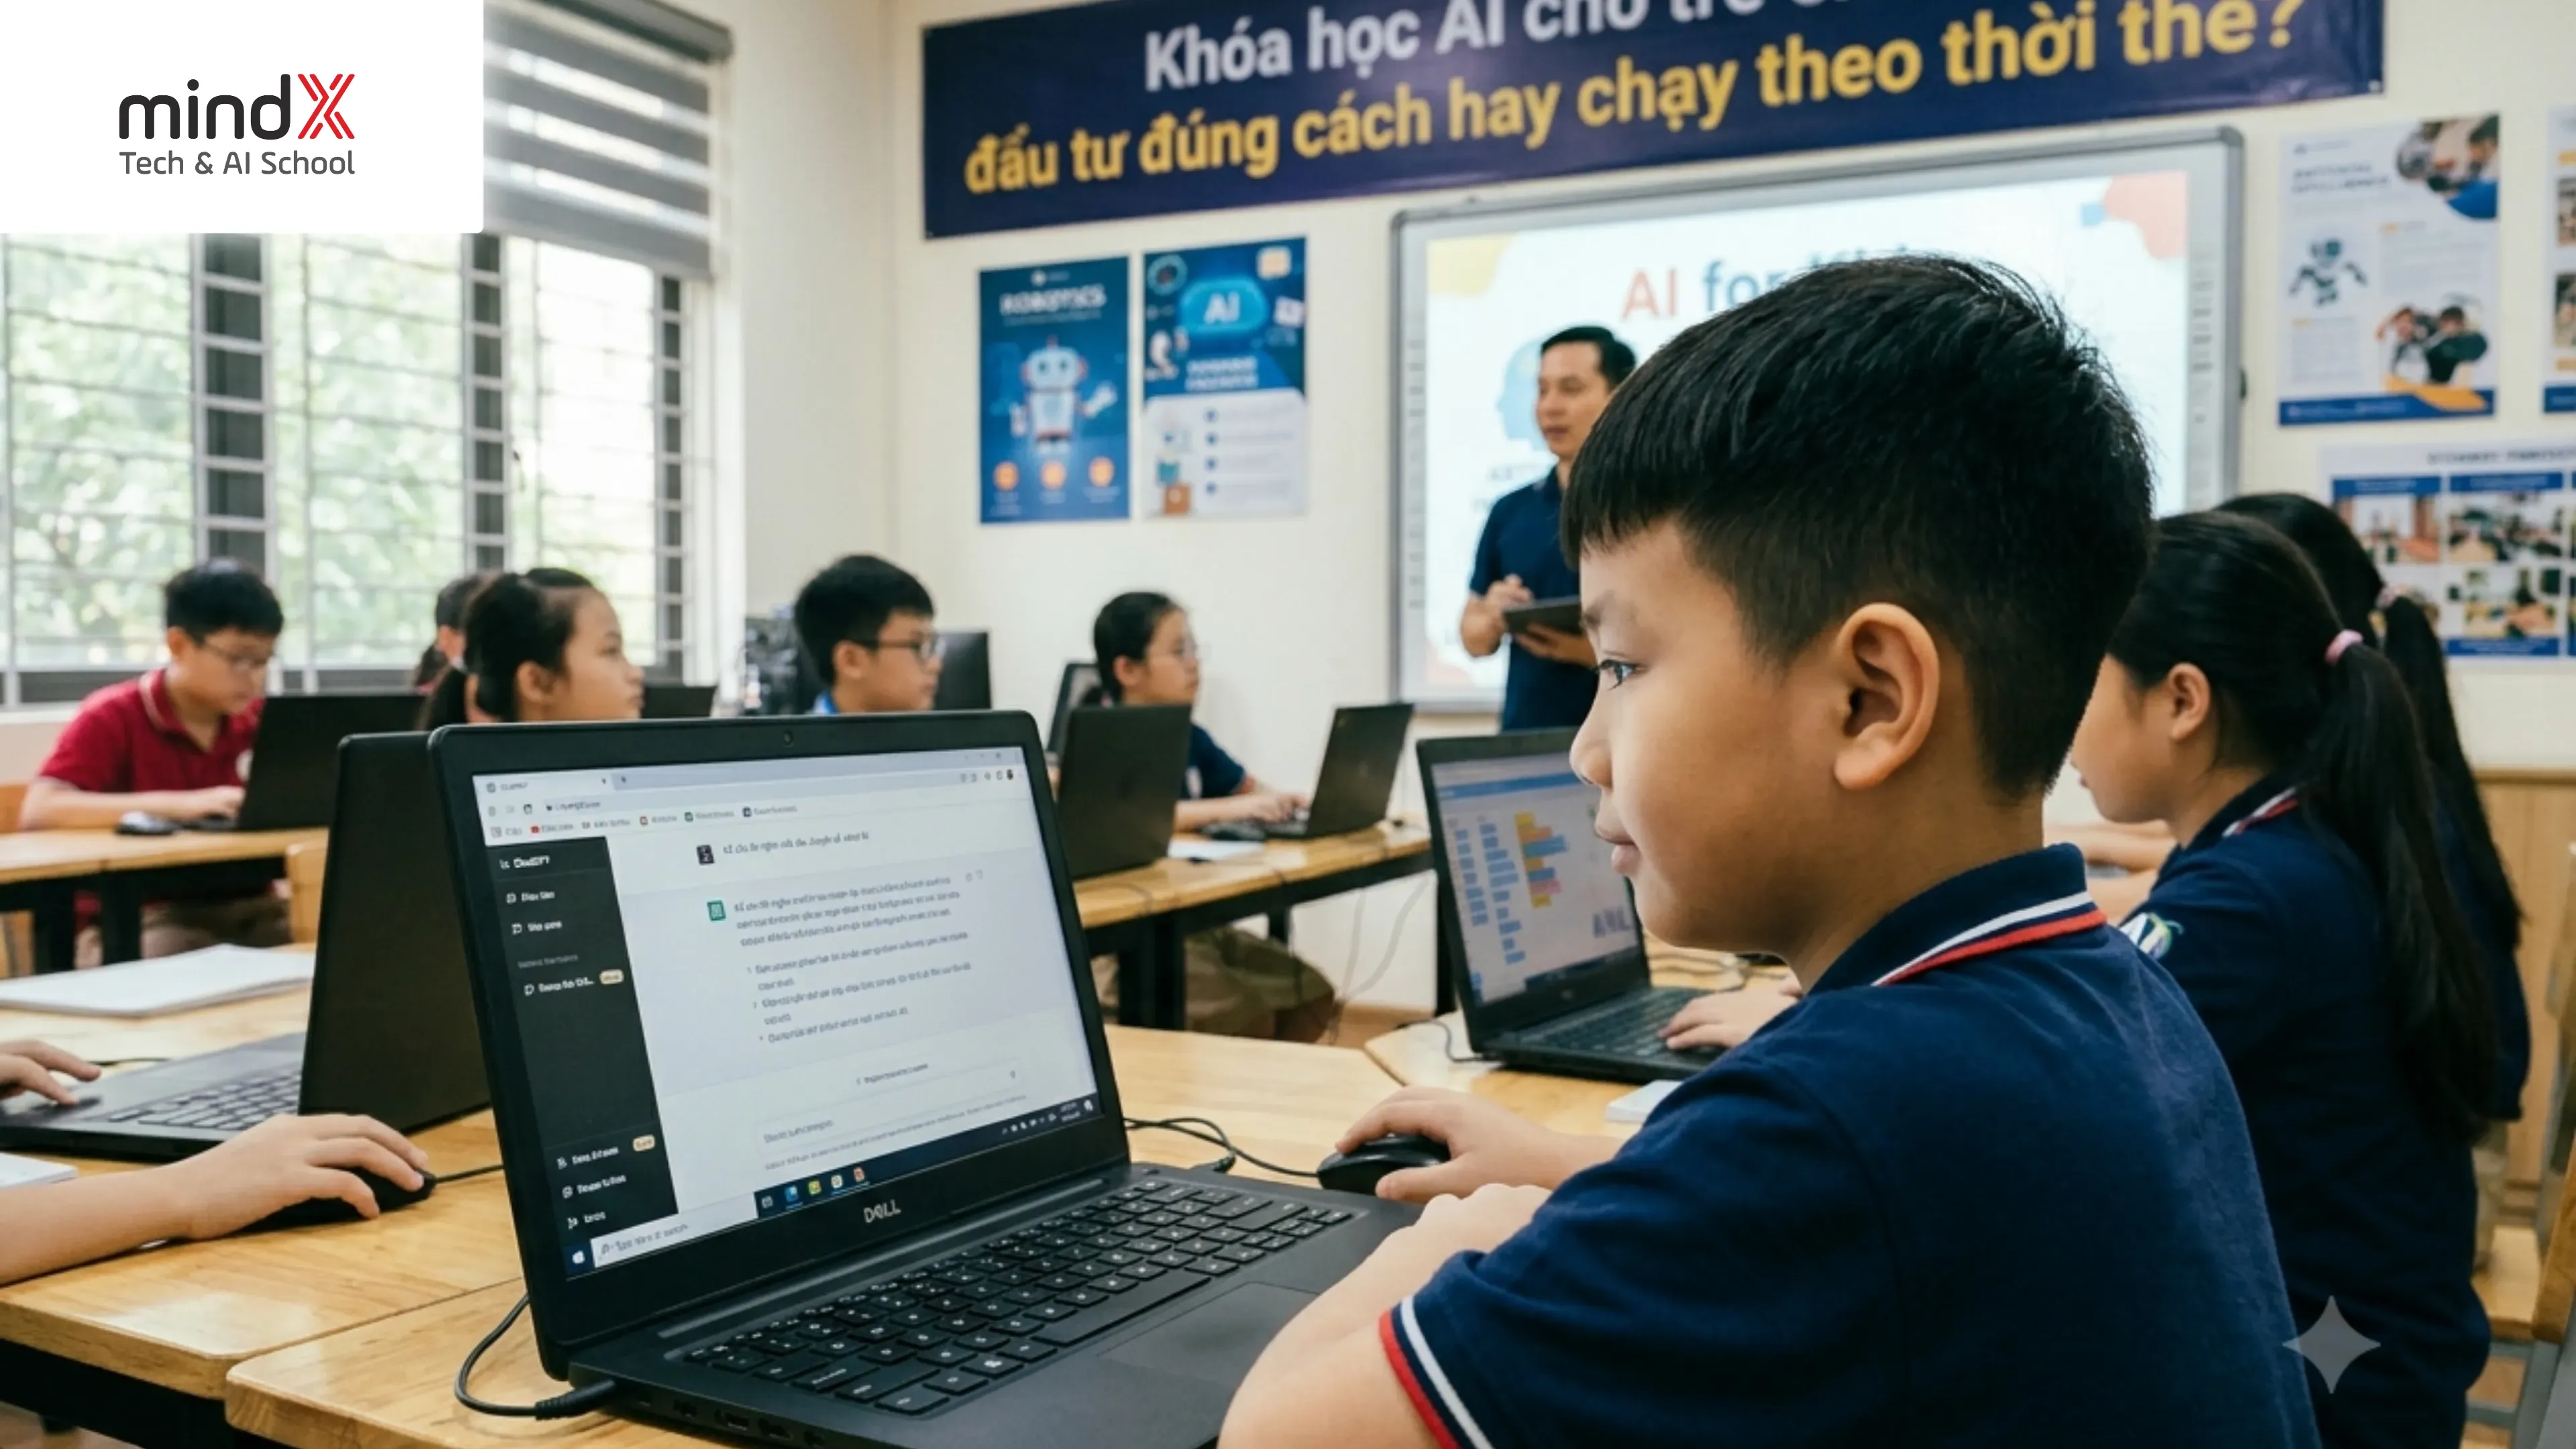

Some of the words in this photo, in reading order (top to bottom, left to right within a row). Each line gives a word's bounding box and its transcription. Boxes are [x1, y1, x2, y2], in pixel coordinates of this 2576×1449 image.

[1070, 127, 1130, 182] tư
[1138, 107, 1280, 179] đúng
[1293, 83, 1432, 158] cách
[1448, 77, 1562, 148] hay
[1576, 56, 1739, 131] chạy
[1755, 34, 1923, 107] theo
[1941, 0, 2097, 86] thời
[1145, 17, 1292, 91] Khóa
[1307, 6, 1422, 79] học
[1434, 0, 1506, 55] AI
[1622, 268, 1676, 319] AI
